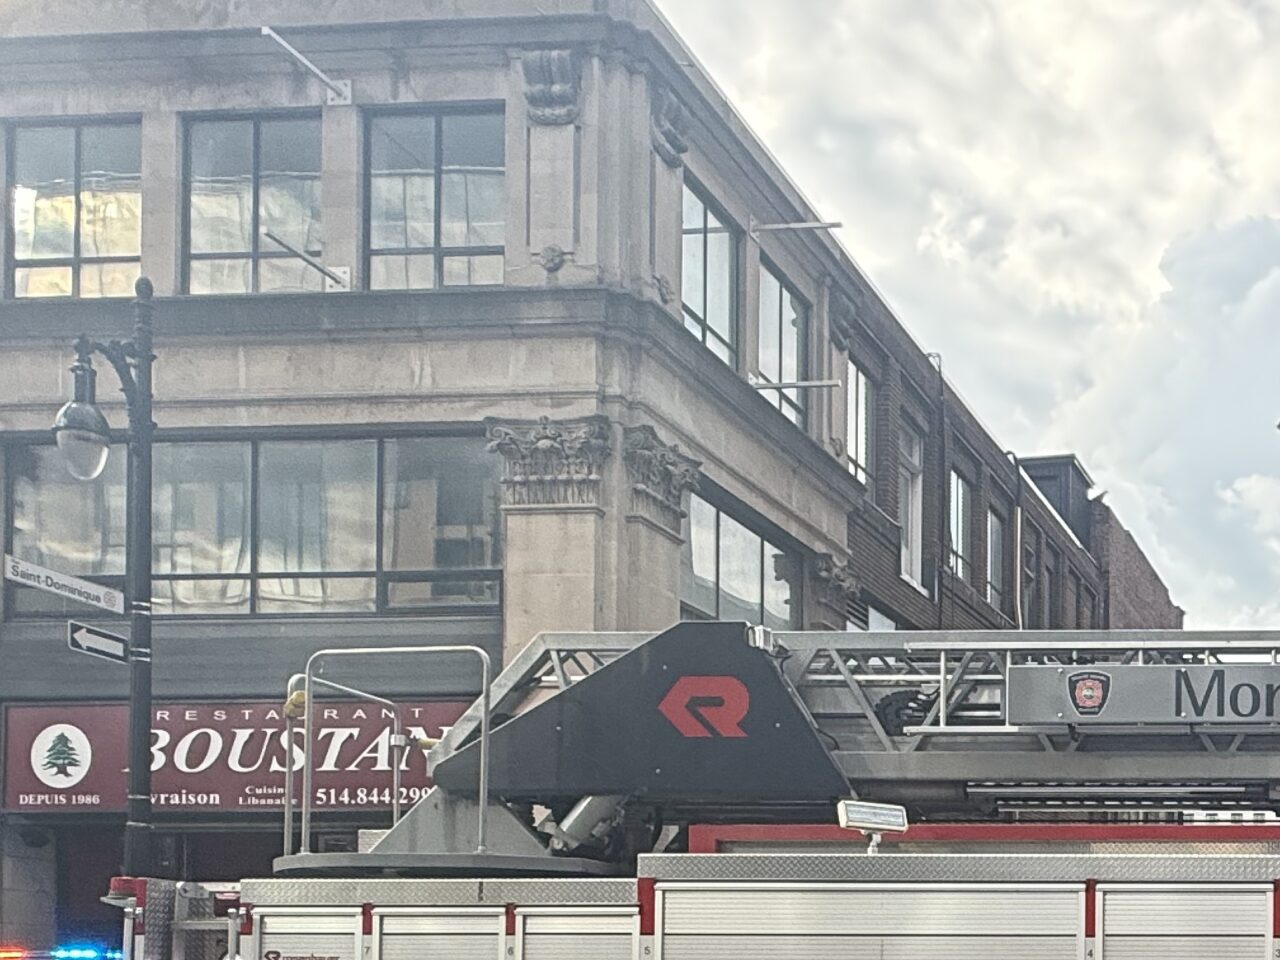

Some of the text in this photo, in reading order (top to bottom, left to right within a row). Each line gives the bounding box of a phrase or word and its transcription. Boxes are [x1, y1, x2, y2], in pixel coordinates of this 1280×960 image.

[11, 564, 103, 604] Saint-Dominique
[156, 707, 424, 721] RESTARANT
[244, 785, 287, 795] Cuisin
[19, 794, 100, 805] DEPUIS 1986
[238, 796, 298, 805] Libanaie
[363, 945, 371, 955] 7
[507, 946, 515, 956] 6
[643, 945, 652, 956] 5
[1086, 948, 1094, 959] 4
